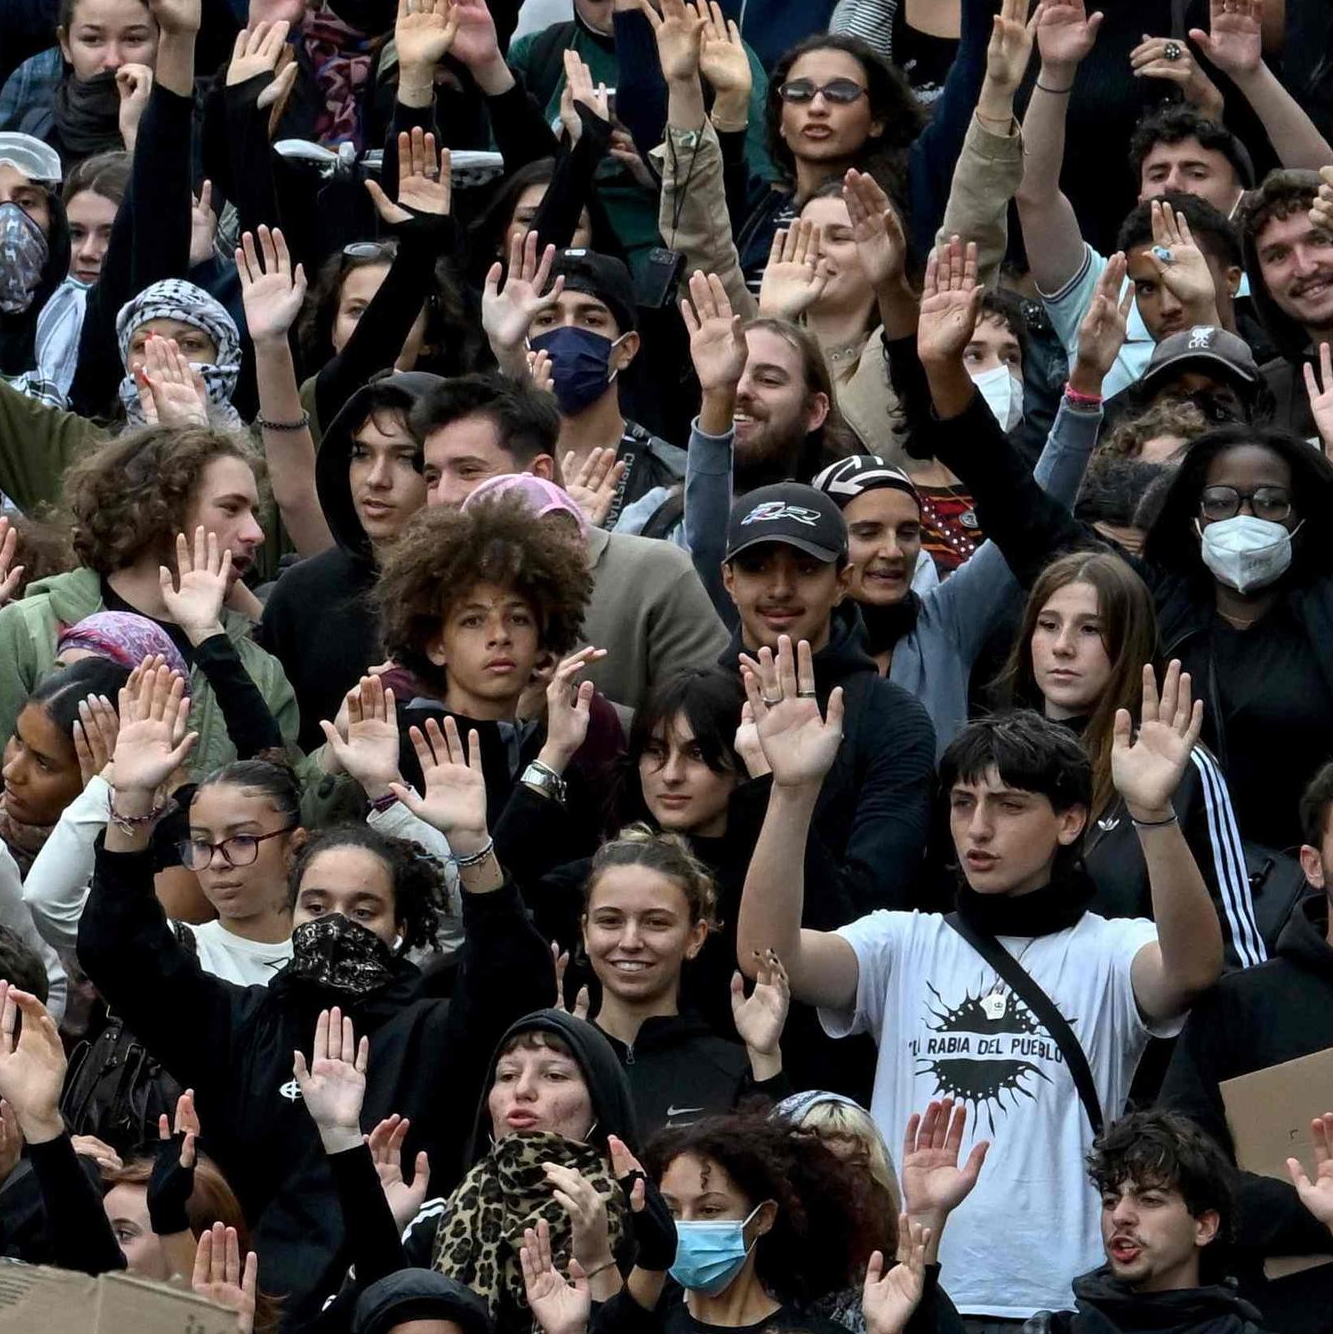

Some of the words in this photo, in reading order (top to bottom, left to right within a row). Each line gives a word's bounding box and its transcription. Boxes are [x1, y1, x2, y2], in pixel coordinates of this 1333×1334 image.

[927, 1037, 971, 1055] RABIA
[977, 1038, 1004, 1055] DEL
[1010, 1037, 1064, 1064] PUEBLO
